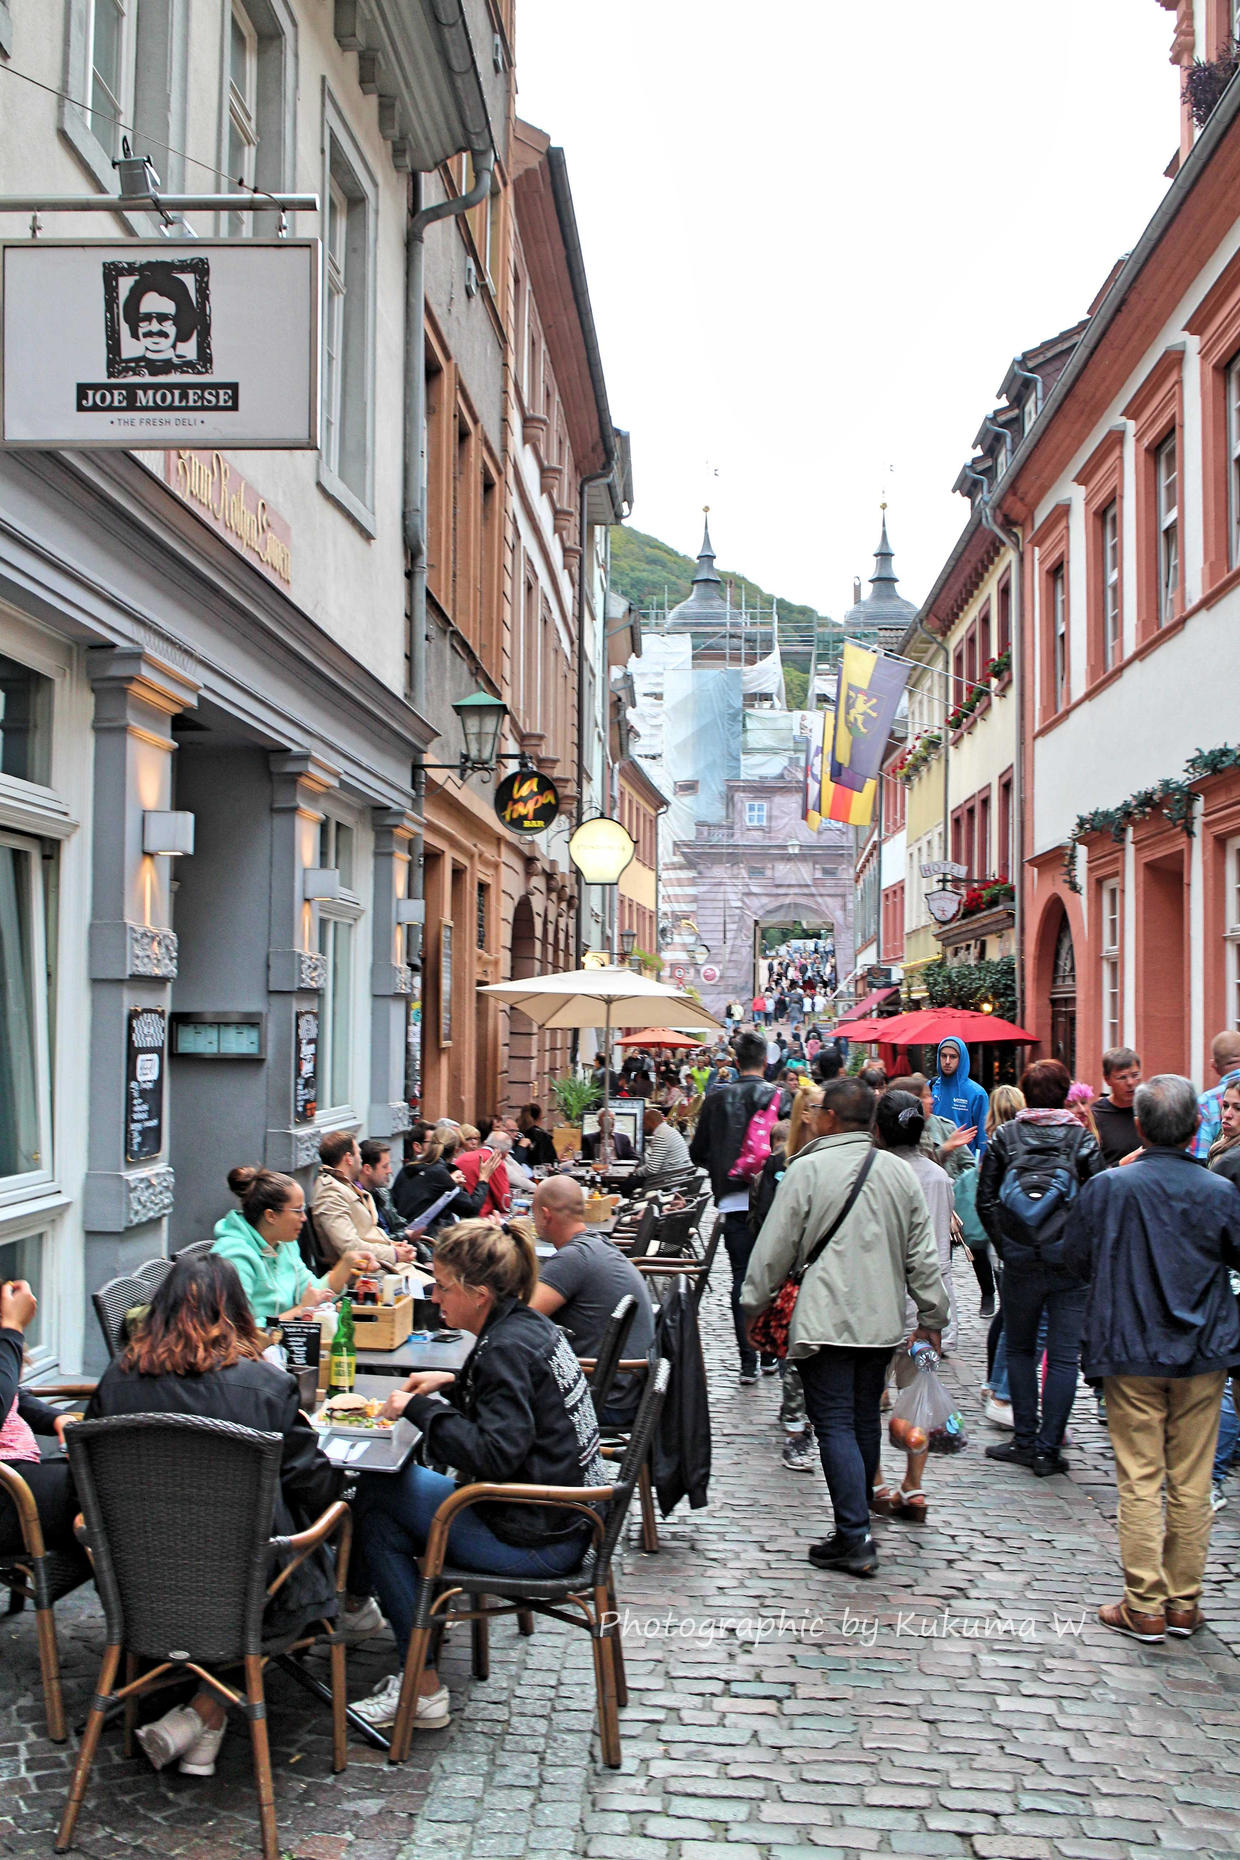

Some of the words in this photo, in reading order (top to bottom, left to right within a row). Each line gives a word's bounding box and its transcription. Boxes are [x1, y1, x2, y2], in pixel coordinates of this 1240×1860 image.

[82, 389, 127, 407] JOE
[135, 389, 233, 407] MOLESE
[117, 418, 136, 427] THE
[139, 418, 171, 427] FRESH
[175, 418, 198, 427] DELI
[512, 774, 539, 800] la
[500, 788, 557, 822] tapa
[523, 820, 546, 828] BAR
[923, 863, 964, 876] HOTEL
